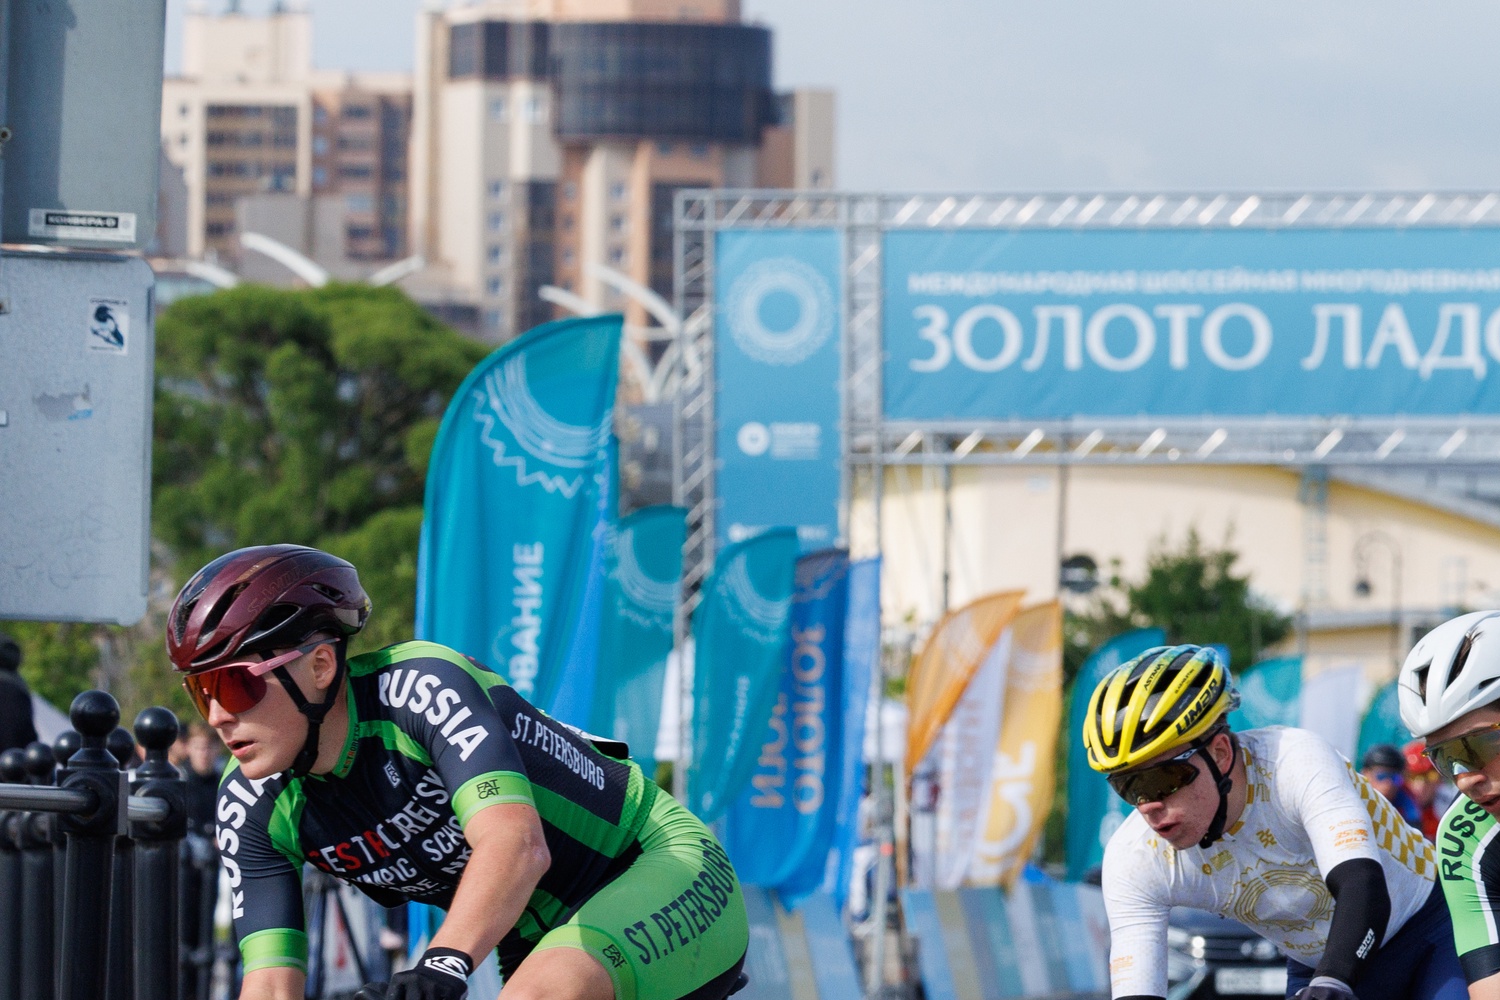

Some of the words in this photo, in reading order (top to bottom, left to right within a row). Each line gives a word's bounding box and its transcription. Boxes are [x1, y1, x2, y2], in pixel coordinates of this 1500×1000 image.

[908, 302, 1274, 373] ЗОЛОТО
[379, 667, 489, 762] RUSSIA
[215, 770, 283, 919] RUSSIA
[1441, 799, 1490, 881] RUSS
